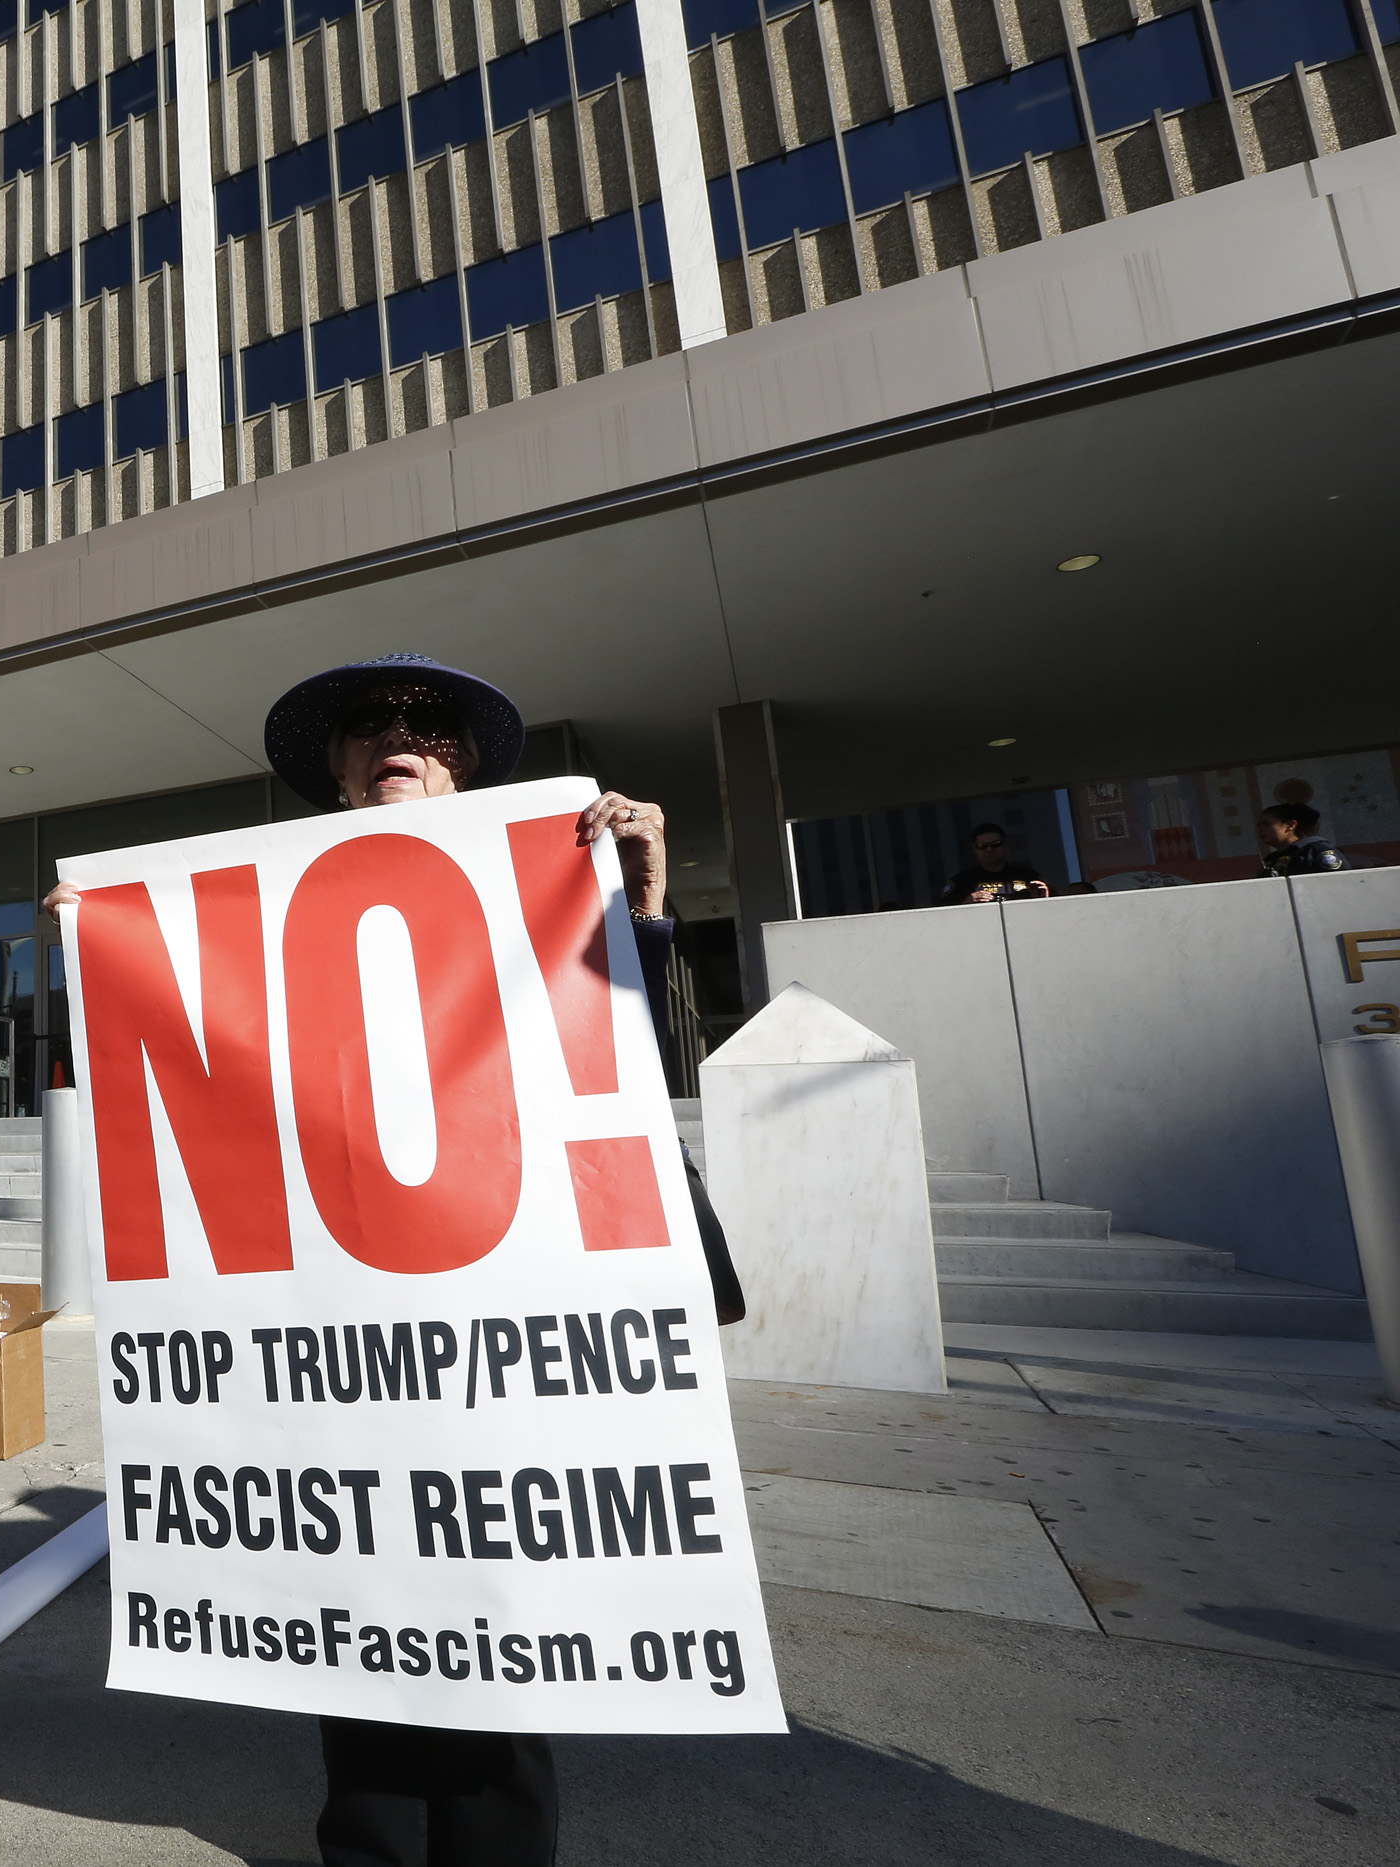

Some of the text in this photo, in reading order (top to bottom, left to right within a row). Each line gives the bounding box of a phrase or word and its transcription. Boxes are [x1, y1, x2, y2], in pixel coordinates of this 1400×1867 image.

[77, 812, 671, 1281] NO!
[111, 1308, 697, 1409] STOP TRUMP/PENCE
[121, 1463, 722, 1561] FASCIST REGIME
[127, 1592, 747, 1697] RefuseFascism.org
